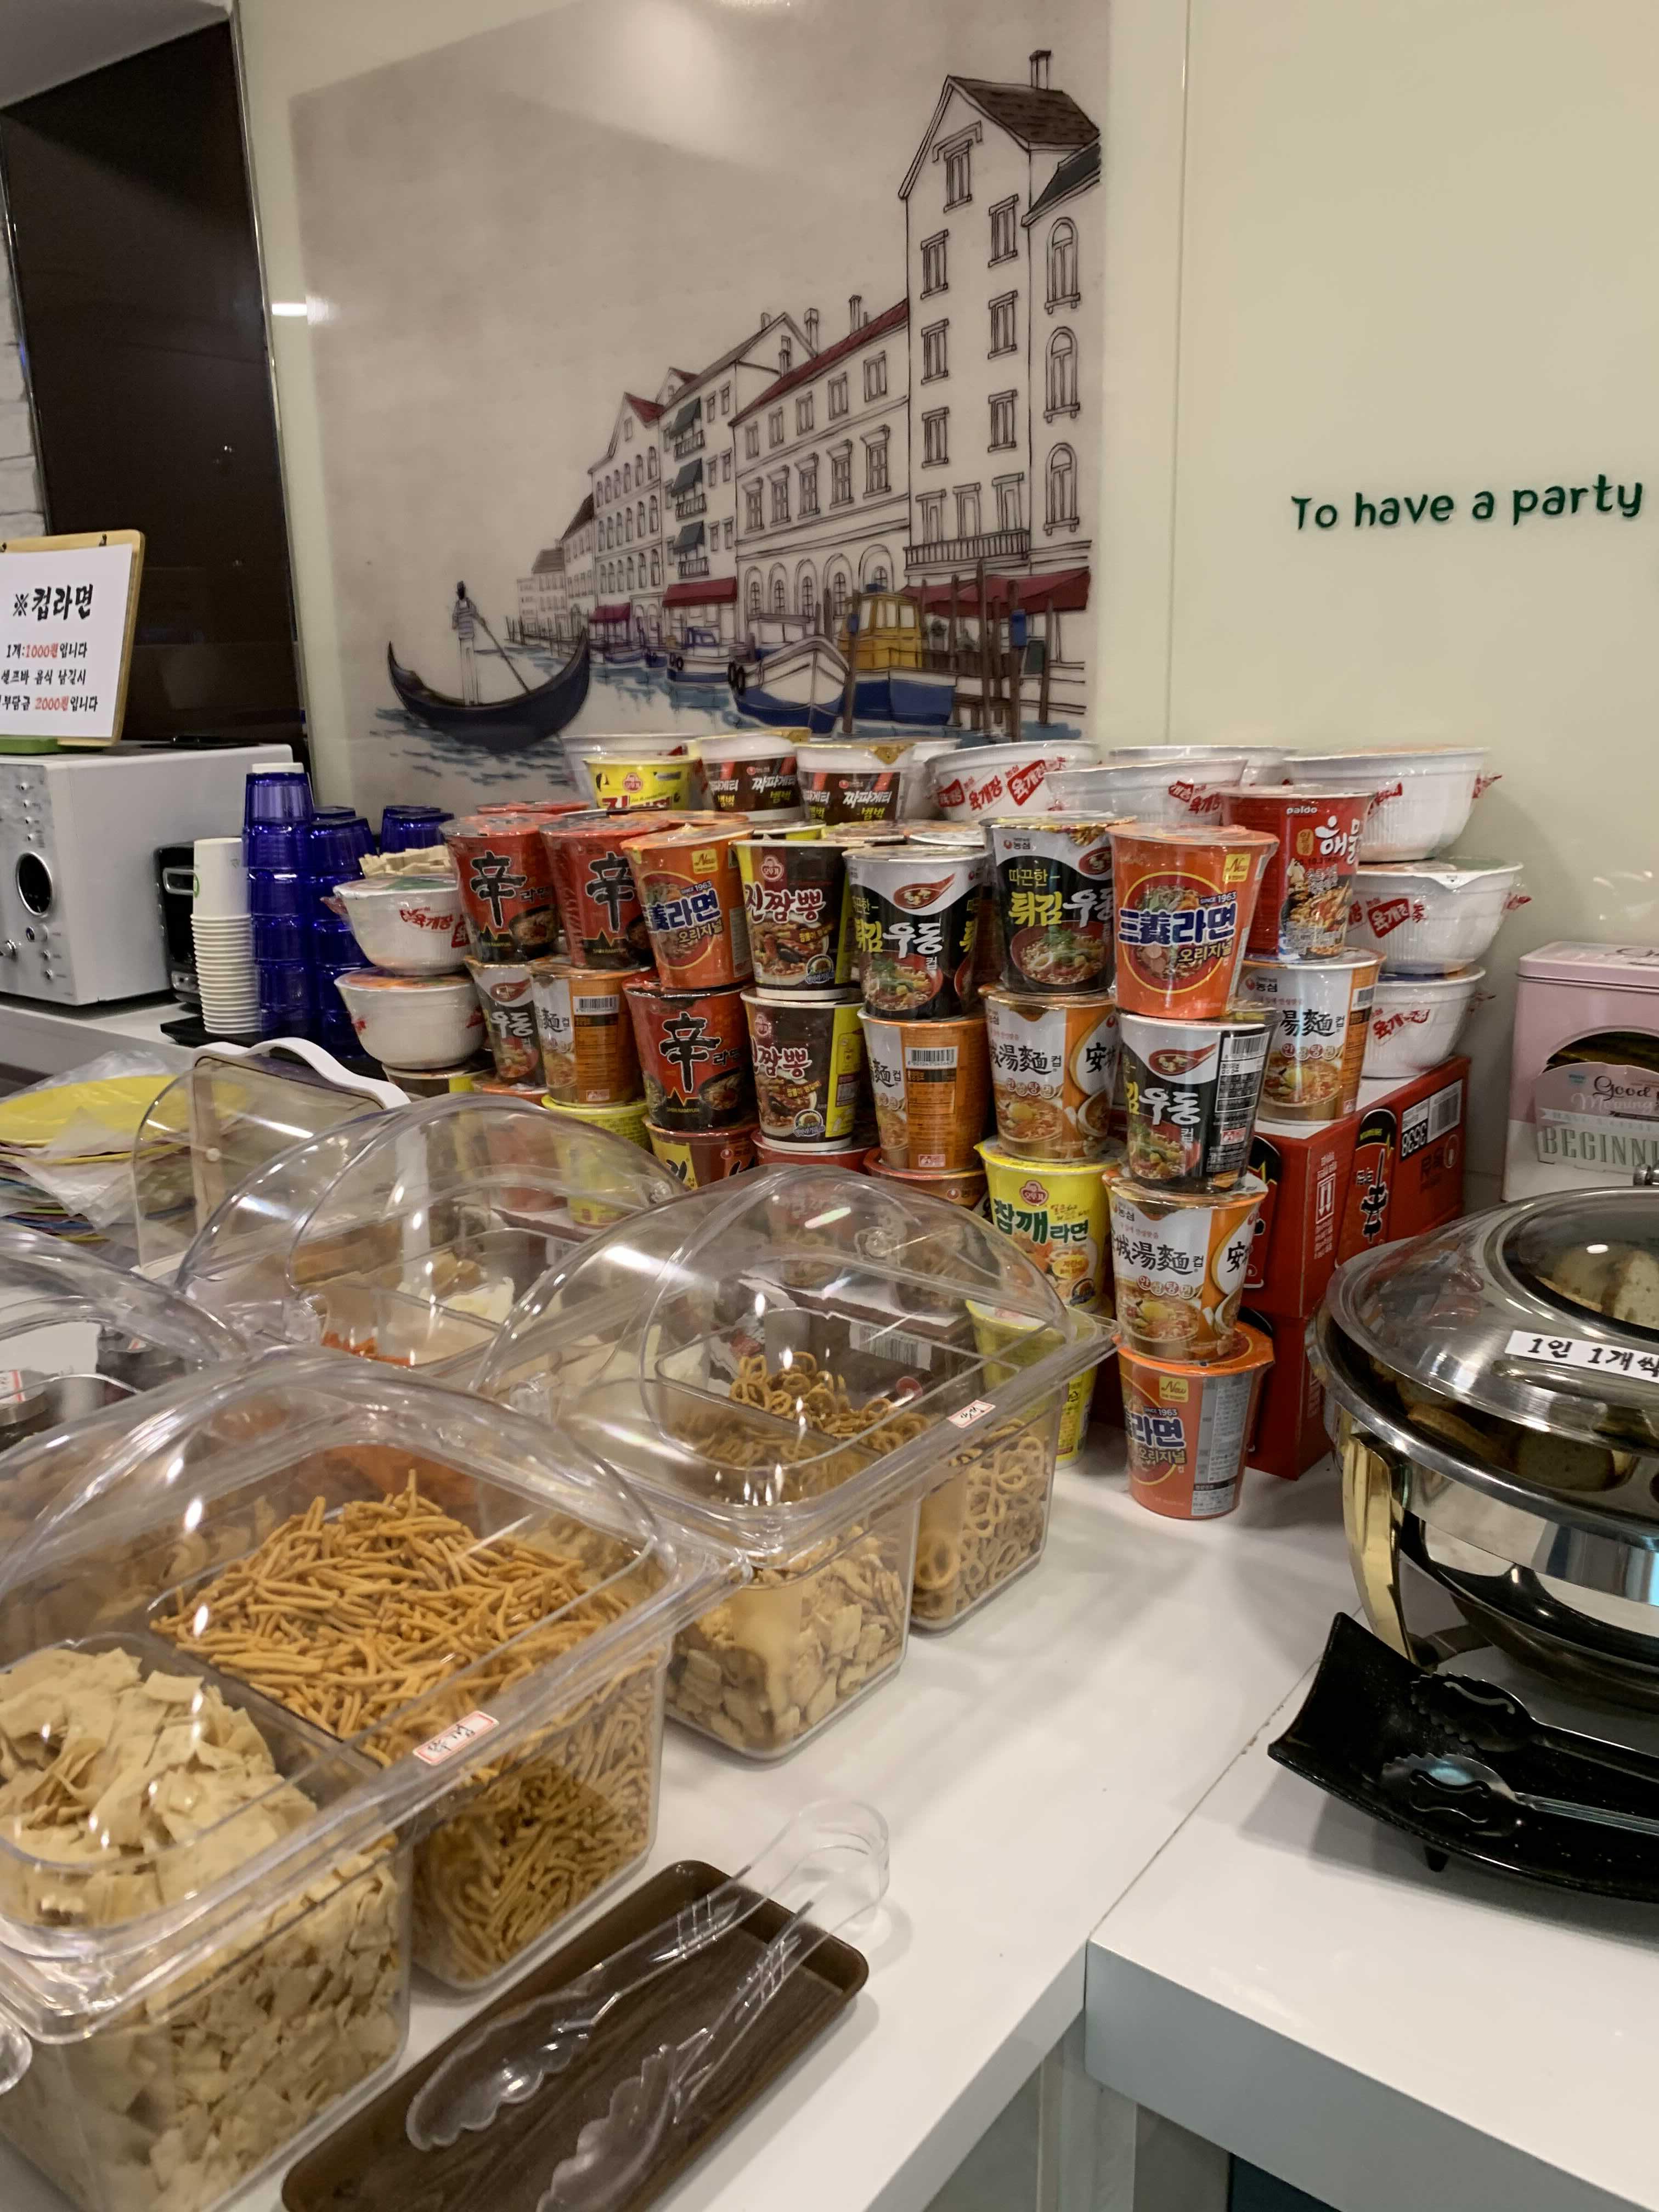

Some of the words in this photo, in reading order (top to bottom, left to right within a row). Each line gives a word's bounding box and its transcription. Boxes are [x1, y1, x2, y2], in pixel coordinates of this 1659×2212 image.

[1291, 495, 1338, 530] To
[1355, 492, 1454, 527] have
[1471, 490, 1495, 521] a
[1513, 473, 1643, 526] party
[1, 669, 30, 685] 셀프바
[35, 669, 53, 685] 음식
[58, 668, 86, 685] 남길시
[0, 695, 31, 712] 부담금
[842, 790, 893, 809] 짜파게티
[1286, 806, 1318, 815] paldo
[470, 850, 527, 929] 辛
[585, 851, 635, 933] 辛
[695, 881, 712, 891] 1963
[744, 881, 827, 924] 진짬뽕
[1217, 891, 1237, 903] 1963
[1177, 939, 1233, 964] 오리지널
[1255, 982, 1278, 992] 농심
[659, 1012, 721, 1093] 辛
[1593, 1075, 1651, 1101] Good
[1193, 1255, 1204, 1268] 컵
[1527, 1338, 1573, 1359] 1인
[1161, 1380, 1187, 1394] New
[1158, 1408, 1178, 1416] 1963
[1139, 1447, 1187, 1463] 오리지널
